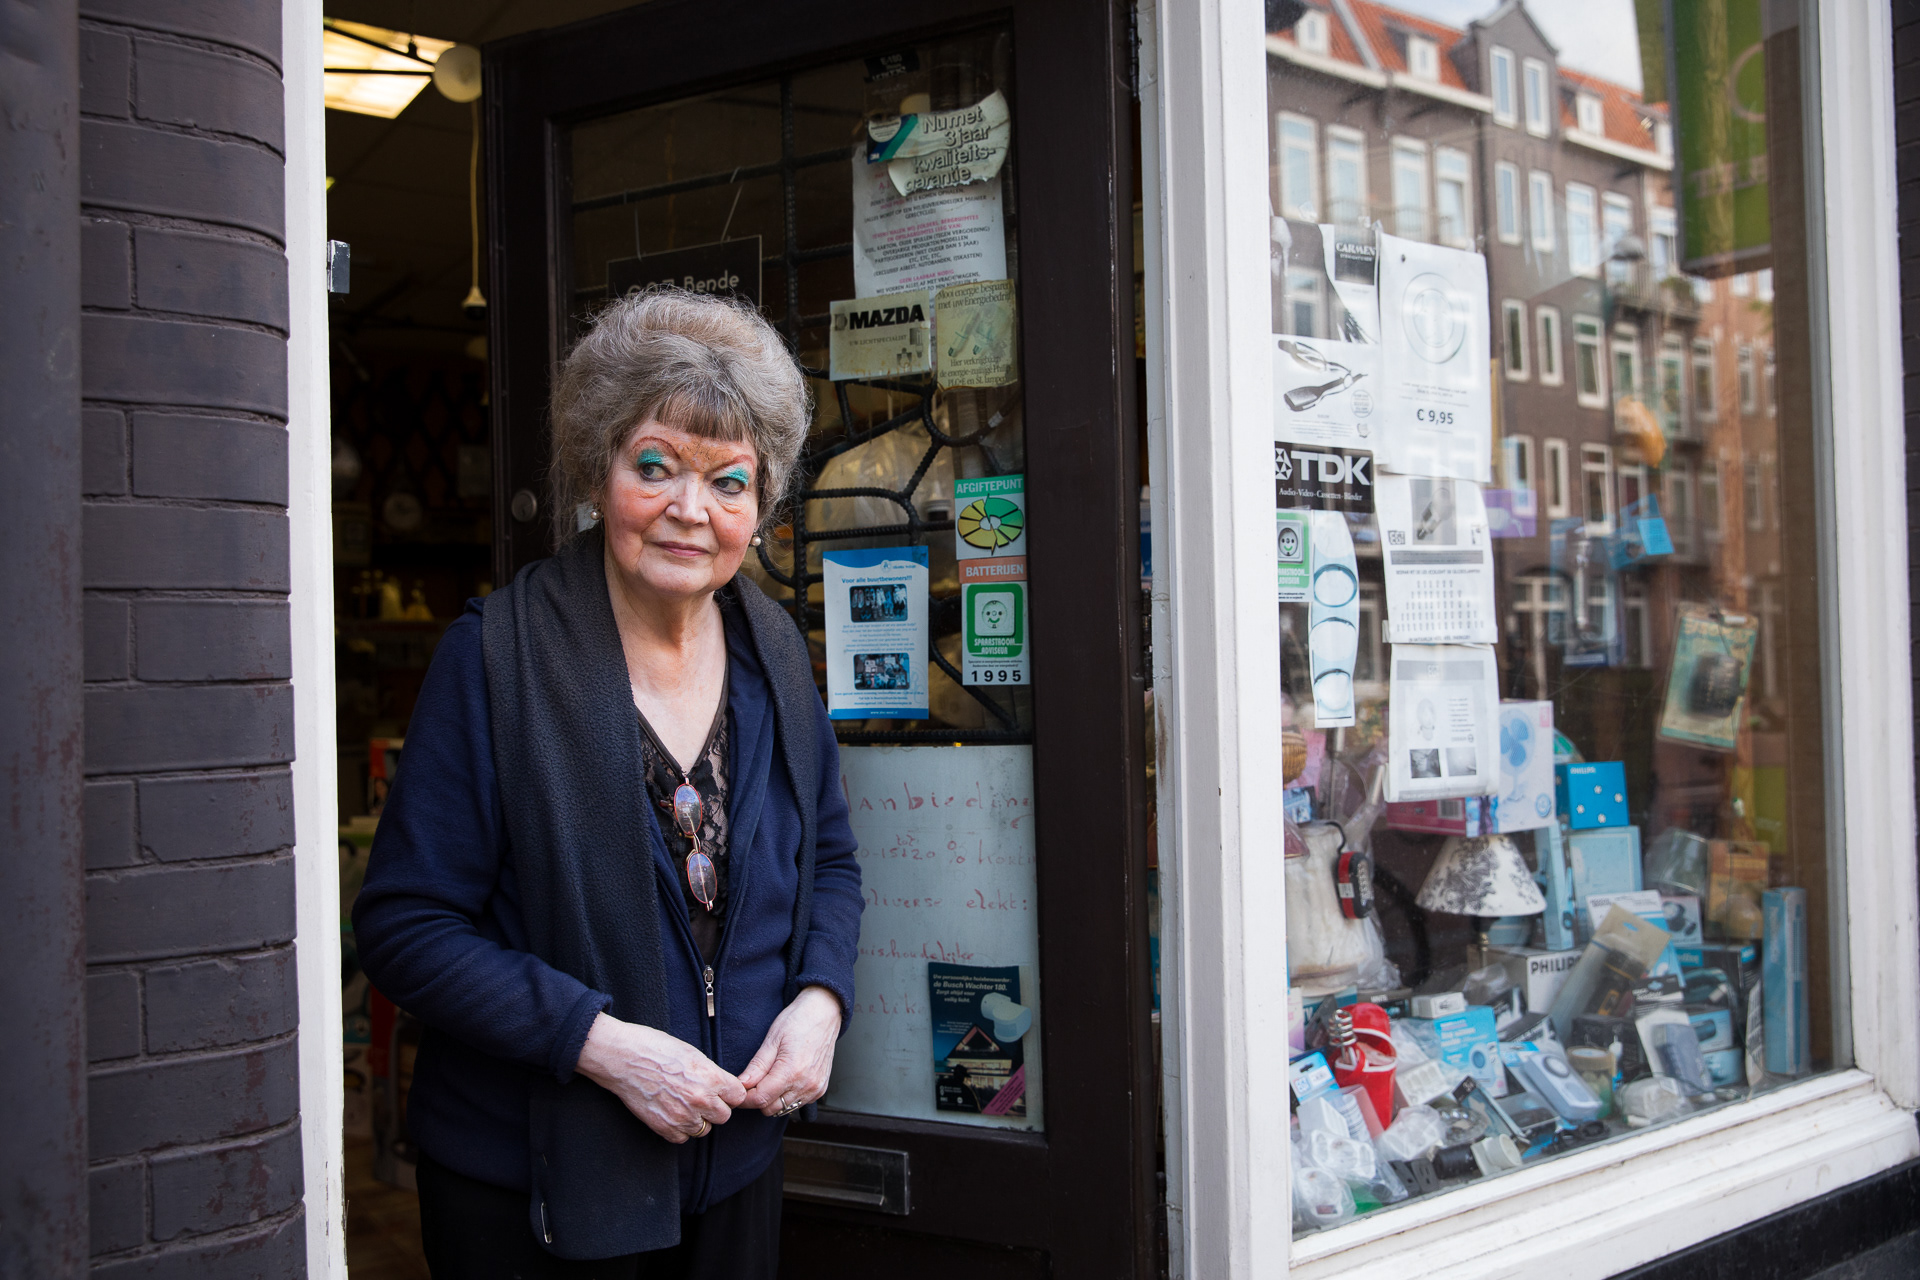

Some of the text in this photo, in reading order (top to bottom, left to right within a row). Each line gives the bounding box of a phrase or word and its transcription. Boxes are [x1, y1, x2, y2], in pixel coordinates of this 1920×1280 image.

[944, 126, 990, 148] 3 jaar
[914, 145, 997, 175] kwaliteits-
[904, 166, 971, 194] garantie
[1336, 242, 1376, 256] CARMEN
[683, 269, 740, 292] Bende
[954, 286, 979, 298] energie
[938, 300, 951, 310] met
[952, 300, 964, 308] uw
[849, 304, 925, 332] MAZDA
[950, 358, 964, 367] Hier
[940, 370, 946, 378] de
[1428, 409, 1454, 425] 9,95
[1290, 450, 1371, 486] TDK
[956, 478, 1023, 494] AFGIFTEPUNT
[966, 564, 1024, 577] BATTERIJEN
[974, 638, 1016, 646] SPAARSTROOM
[981, 646, 1008, 655] ADVISEUR
[971, 670, 1022, 683] 1995
[965, 982, 994, 990] Wachter
